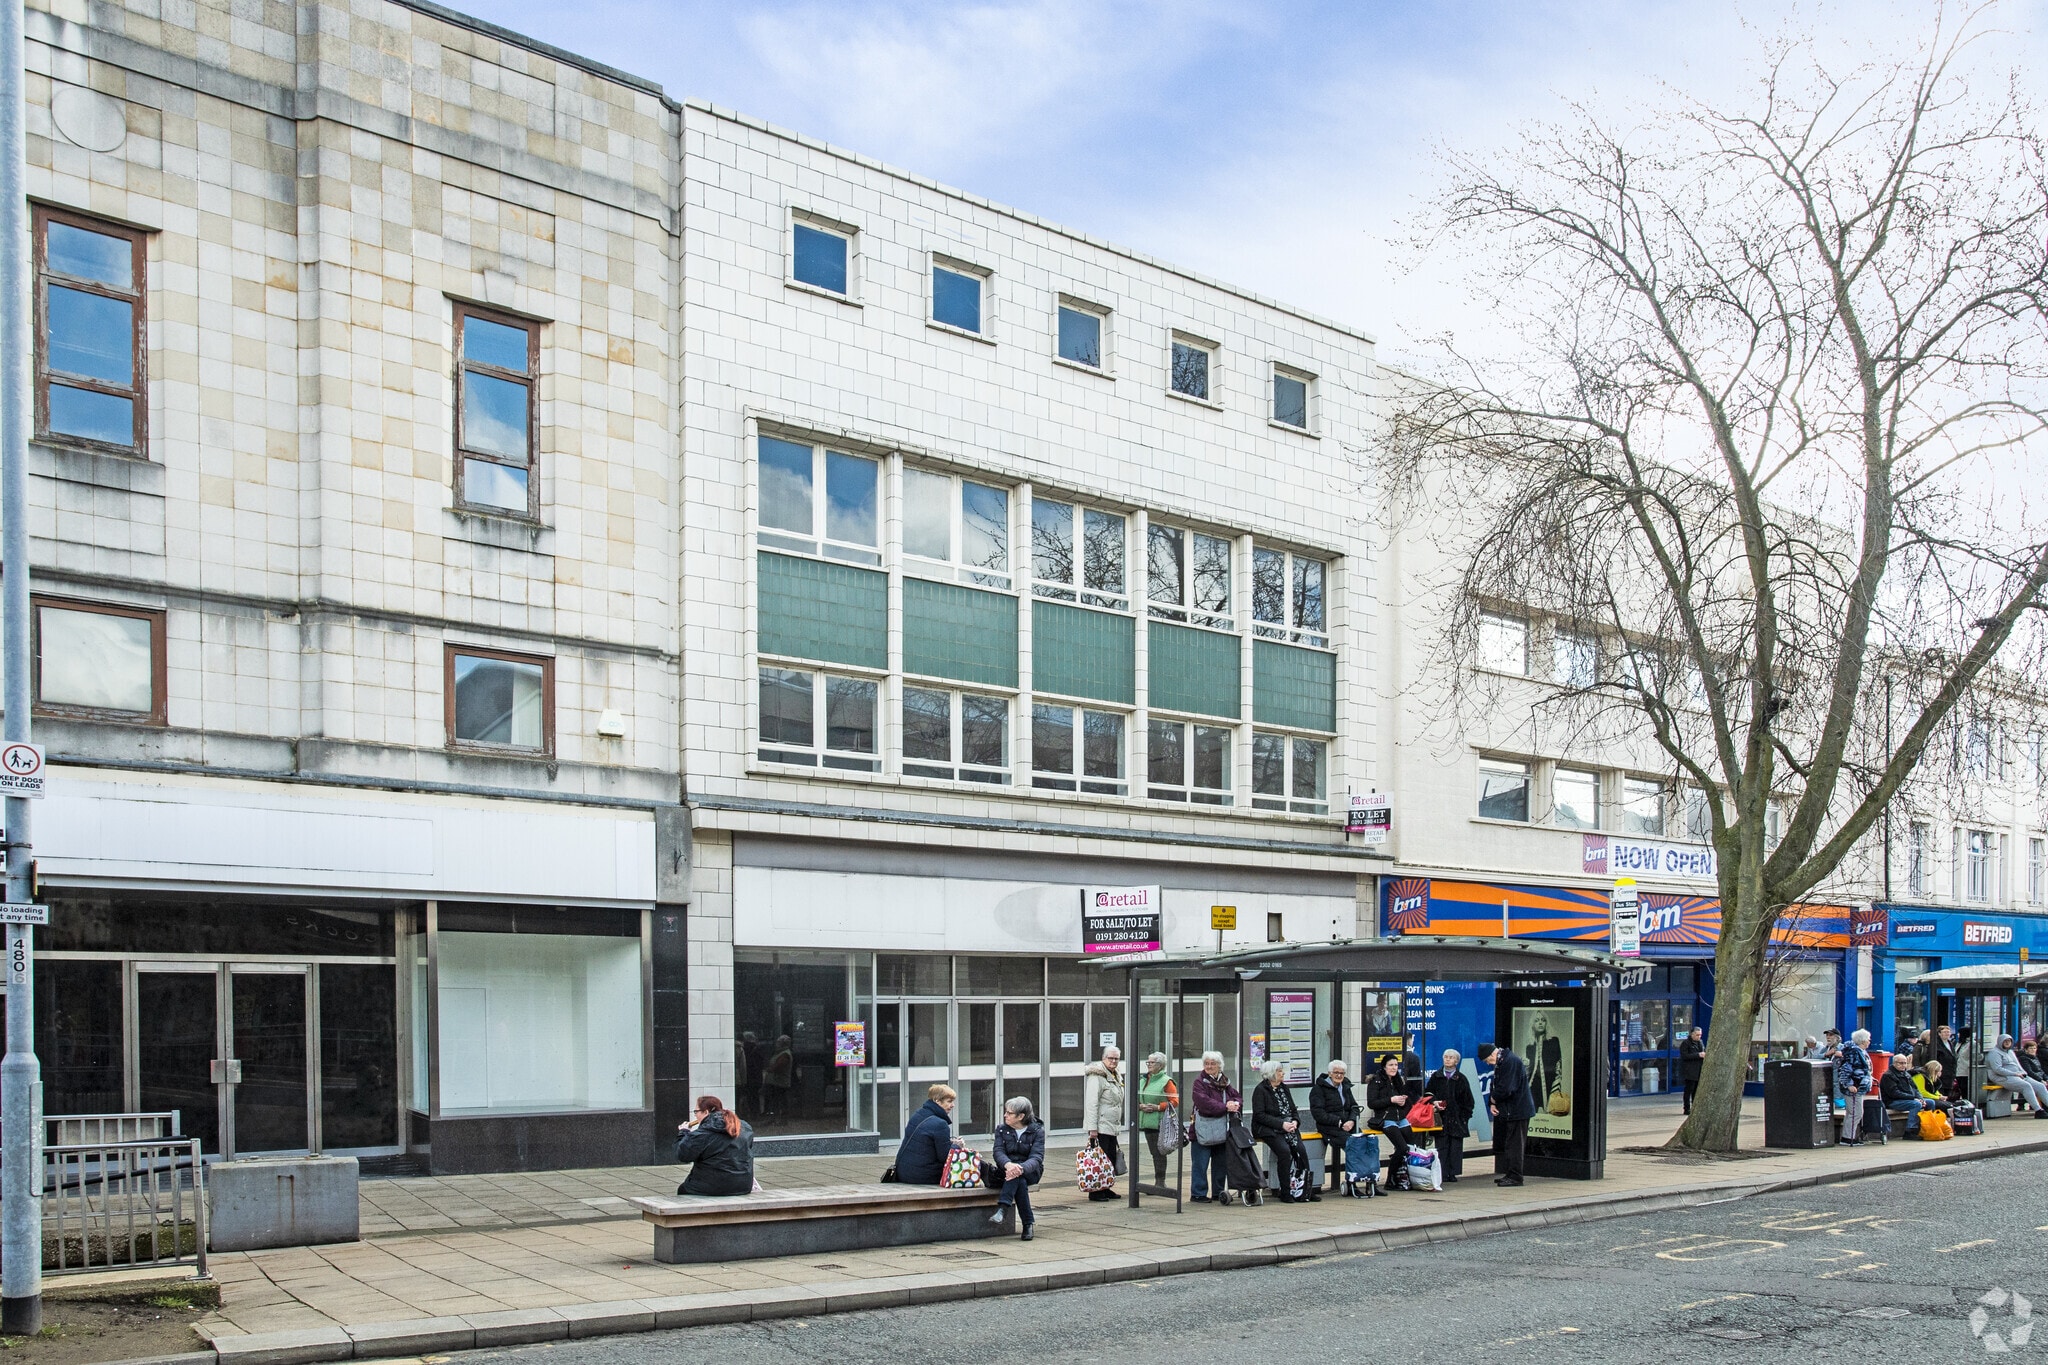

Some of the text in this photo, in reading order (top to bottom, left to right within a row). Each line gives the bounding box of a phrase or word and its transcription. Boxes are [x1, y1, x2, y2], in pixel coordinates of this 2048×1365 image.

[1352, 810, 1386, 819] TO LET
[1615, 845, 1712, 875] NOW OPEN
[1097, 889, 1149, 907] @retail
[11, 906, 43, 914] loading
[1090, 918, 1104, 929] FOR
[1138, 916, 1153, 927] LET
[1640, 902, 1681, 935] b&m
[1896, 925, 1935, 933] BETFRED
[1964, 924, 2012, 943] BETFRED
[1095, 931, 1149, 941] 0191 280 4120
[1095, 943, 1149, 951] www.atretail.co.uk
[1425, 985, 1445, 994] RINKS
[1272, 995, 1284, 1003] Stop
[1406, 1010, 1435, 1018] LEANNG
[1406, 1022, 1437, 1031] OILETRIES
[1535, 1125, 1571, 1135] rabanne
